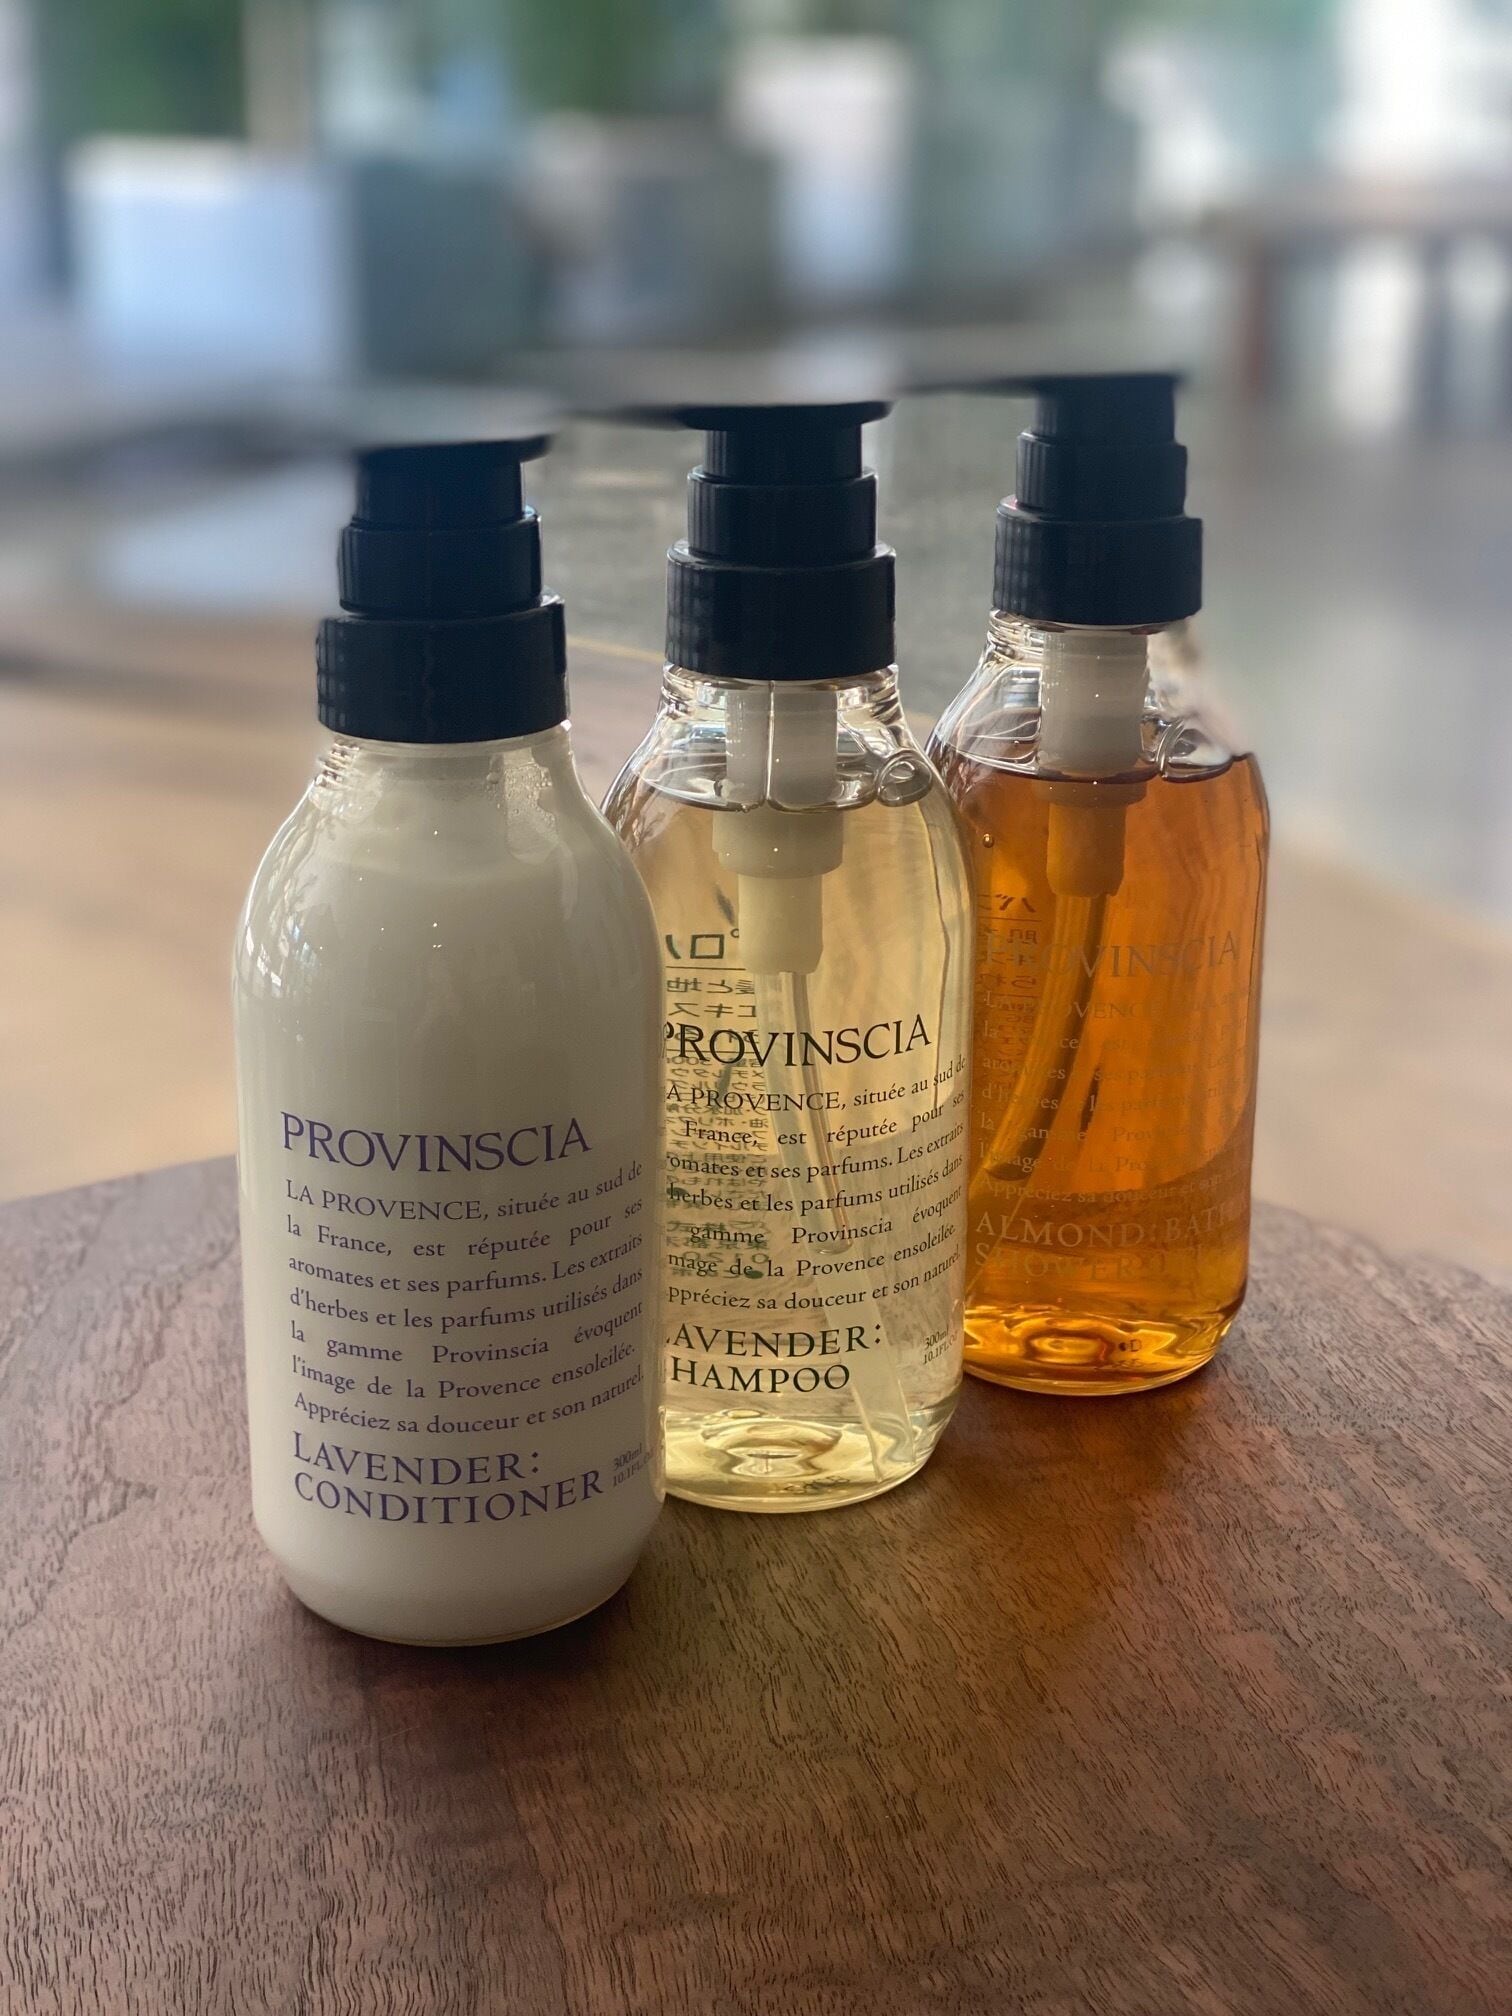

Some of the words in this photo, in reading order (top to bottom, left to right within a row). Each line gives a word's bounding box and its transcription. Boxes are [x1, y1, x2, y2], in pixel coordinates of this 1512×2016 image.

[691, 1087, 846, 1112] PROVENCE,
[853, 1083, 906, 1107] située
[911, 1079, 929, 1095] au
[933, 1061, 954, 1087] sud
[956, 1053, 966, 1073] de
[281, 1111, 592, 1172] PROVINSCIA
[686, 1120, 758, 1145] France,
[778, 1131, 807, 1145] est
[827, 1118, 898, 1147] réputée
[911, 1104, 944, 1132] pour
[952, 1089, 965, 1107] ses
[667, 1154, 739, 1176] omates
[745, 1163, 767, 1178] et
[770, 1166, 801, 1178] ses
[806, 1156, 893, 1183] parfums.
[898, 1147, 923, 1164] Les
[926, 1122, 964, 1154] extraits
[286, 1179, 314, 1205] LA
[322, 1190, 488, 1220] PROVENCE,
[497, 1193, 560, 1217] située
[567, 1189, 589, 1205] au
[595, 1168, 624, 1196] sud
[627, 1160, 642, 1181] de
[669, 1182, 733, 1209] herbes
[740, 1197, 760, 1211] et
[767, 1193, 794, 1212] les
[801, 1190, 882, 1217] parfums
[889, 1169, 939, 1198] utilisés
[942, 1153, 964, 1178] dans
[690, 1226, 765, 1244] gamme
[792, 1217, 893, 1245] Provinscia
[912, 1185, 962, 1223] évoquent
[287, 1214, 302, 1237] la
[318, 1225, 392, 1256] France,
[413, 1242, 446, 1256] est
[468, 1231, 551, 1260] réputée
[569, 1215, 612, 1247] pour
[624, 1199, 643, 1219] ses
[289, 1257, 374, 1288] aromates
[380, 1276, 401, 1290] et
[407, 1280, 440, 1292] ses
[447, 1271, 547, 1298] parfums.
[551, 1261, 585, 1279] Les
[590, 1233, 643, 1268] extraits
[668, 1254, 718, 1277] mage
[730, 1257, 754, 1276] de
[767, 1260, 785, 1277] la
[797, 1252, 885, 1276] Provence
[668, 1286, 750, 1309] ppréciez
[757, 1295, 776, 1309] sa
[785, 1292, 867, 1310] douceur
[872, 1283, 889, 1299] et
[893, 1275, 920, 1295] son
[923, 1244, 962, 1283] naturel.
[290, 1287, 369, 1322] d'herbes
[376, 1313, 396, 1325] et
[404, 1308, 433, 1328] les
[441, 1307, 536, 1334] parfums
[543, 1285, 608, 1318] utilisés
[612, 1268, 643, 1295] dans
[291, 1320, 305, 1342] la
[327, 1339, 403, 1362] gamme
[432, 1338, 549, 1363] Provinscia
[574, 1301, 644, 1343] évoquent
[667, 1322, 882, 1358] AVENDER:
[924, 1323, 949, 1350] 300ml
[293, 1354, 356, 1394] l'image
[367, 1376, 393, 1395] de
[407, 1379, 425, 1398] la
[438, 1377, 541, 1399] Provence
[294, 1392, 390, 1431] Appréciez
[397, 1420, 419, 1432] sa
[426, 1415, 520, 1434] douceur
[526, 1410, 546, 1425] et
[552, 1398, 586, 1420] son
[591, 1364, 645, 1408] naturel.
[671, 1356, 851, 1394] HAMPOO
[293, 1431, 539, 1485] LAVENDER:
[614, 1442, 642, 1471] 300ml
[294, 1470, 604, 1525] CONDITIONER
